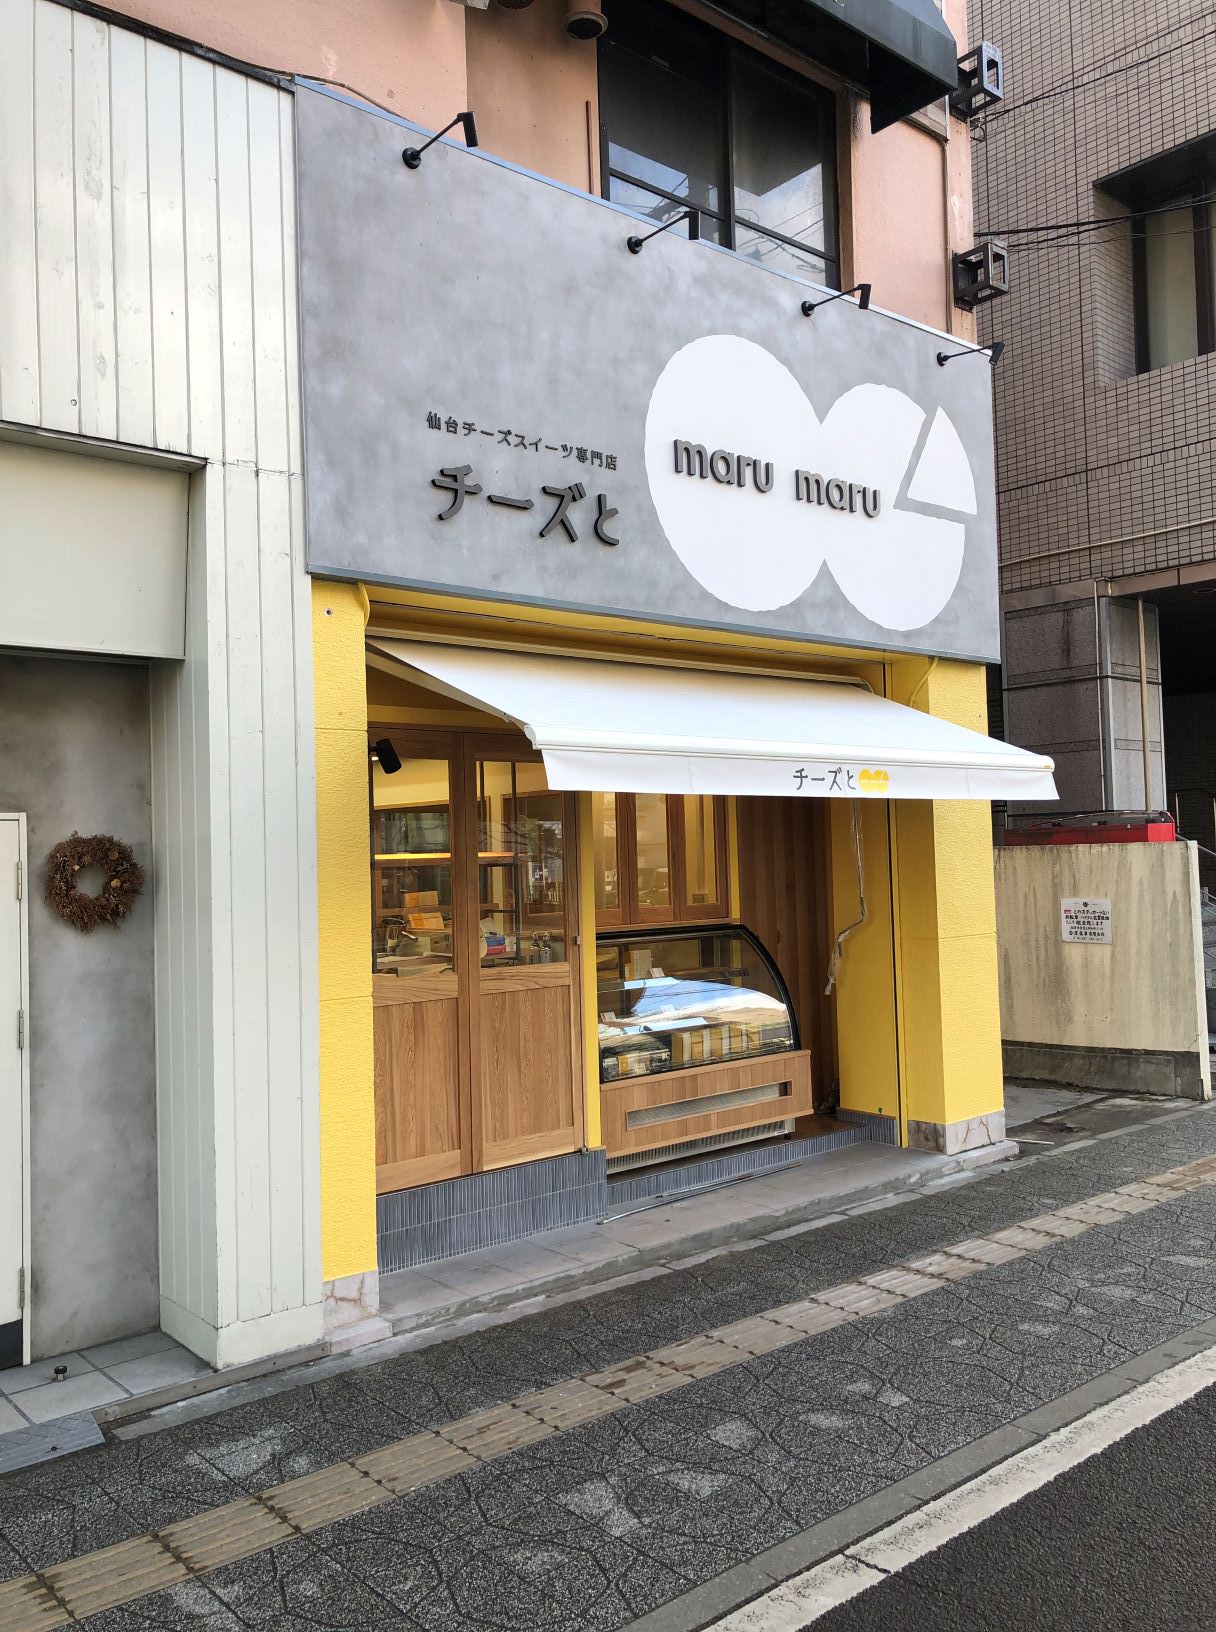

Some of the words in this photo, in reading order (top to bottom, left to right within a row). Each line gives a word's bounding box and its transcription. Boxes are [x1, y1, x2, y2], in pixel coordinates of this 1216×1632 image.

[427, 411, 618, 471] 仙台チーズスイーツ専門店
[431, 464, 620, 546] チーズと
[673, 438, 775, 493] maru
[795, 468, 882, 519] maru
[793, 766, 856, 791] チーズと
